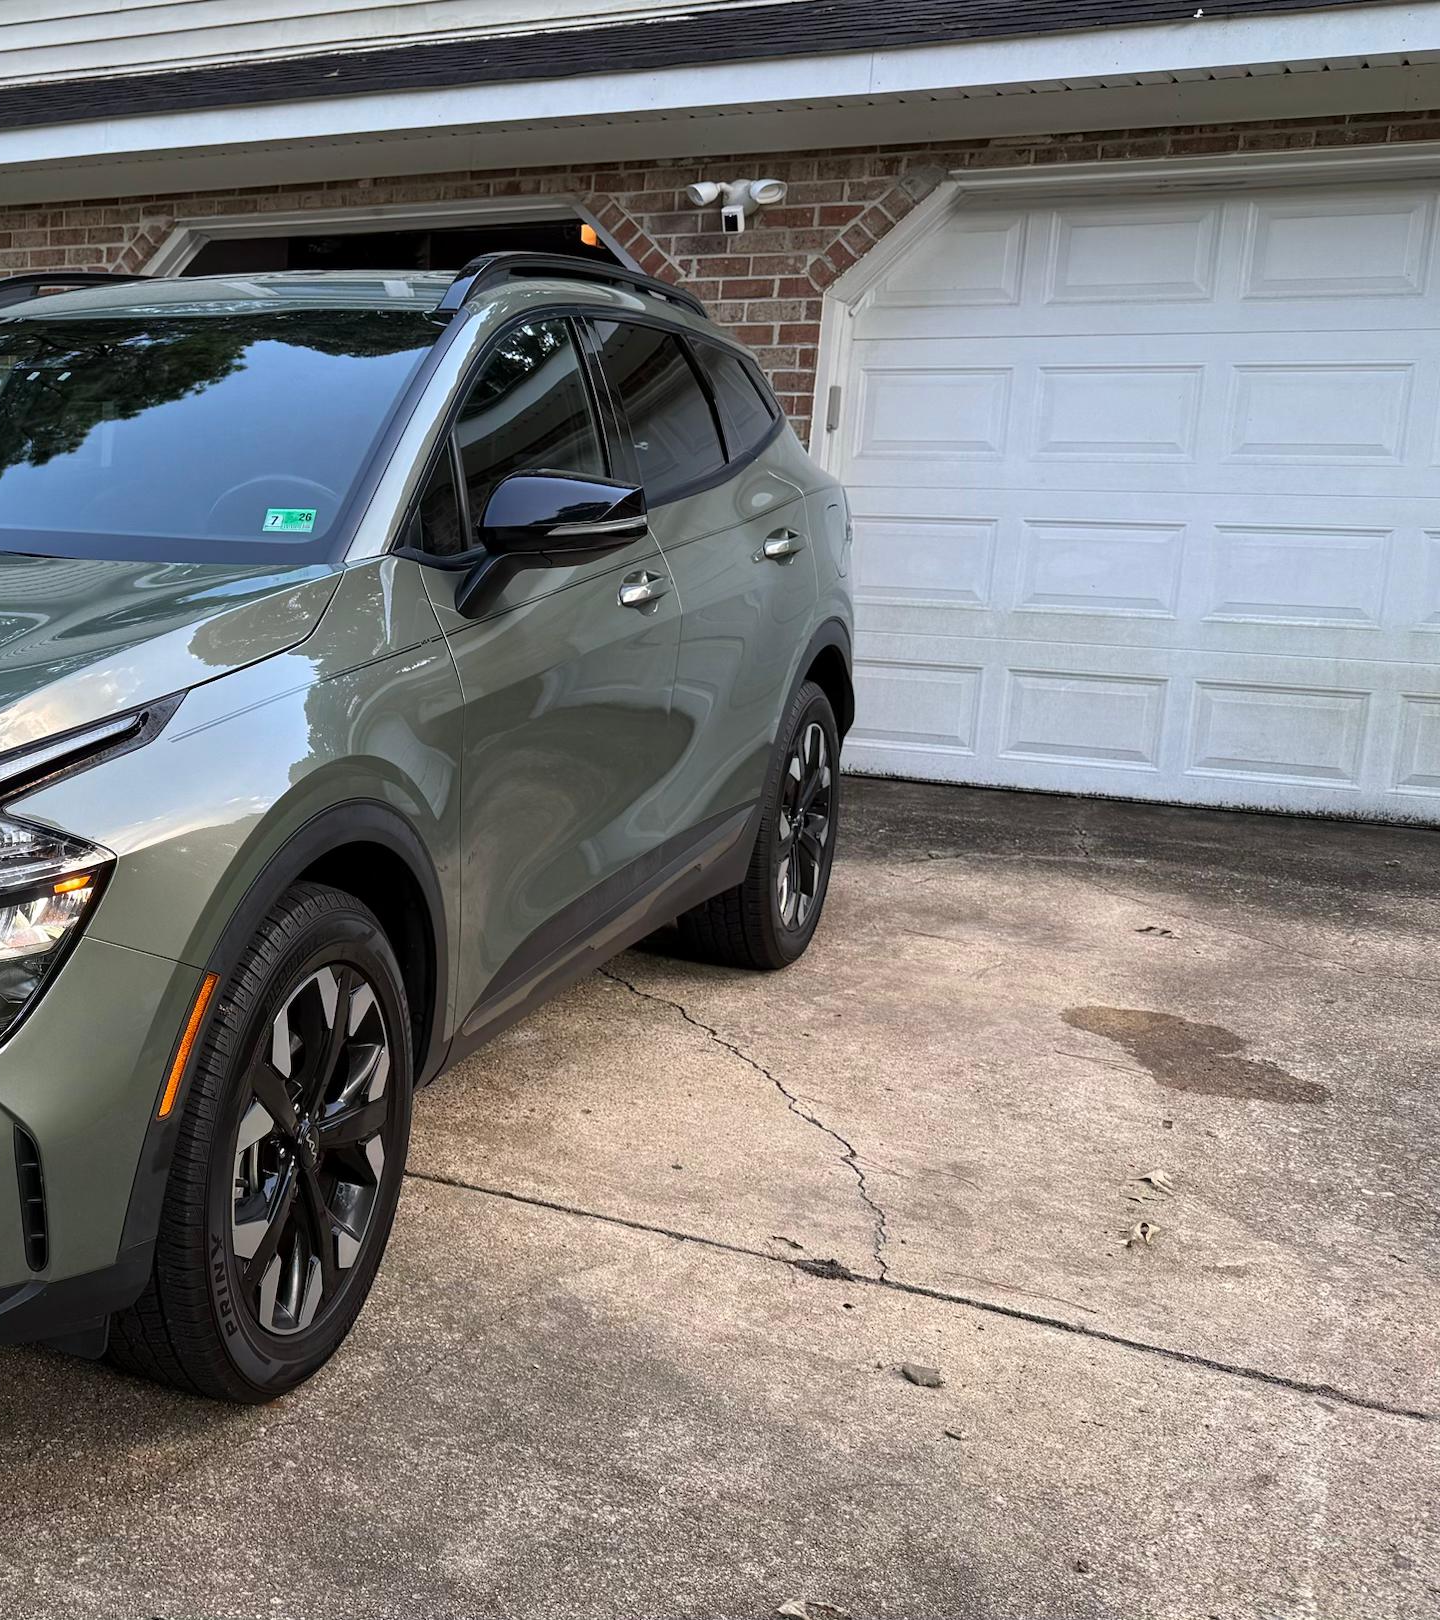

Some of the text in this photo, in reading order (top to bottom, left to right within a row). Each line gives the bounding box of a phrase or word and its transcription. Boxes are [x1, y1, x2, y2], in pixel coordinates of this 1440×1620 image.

[271, 513, 312, 525] 7 26
[211, 1233, 238, 1337] PRINX
